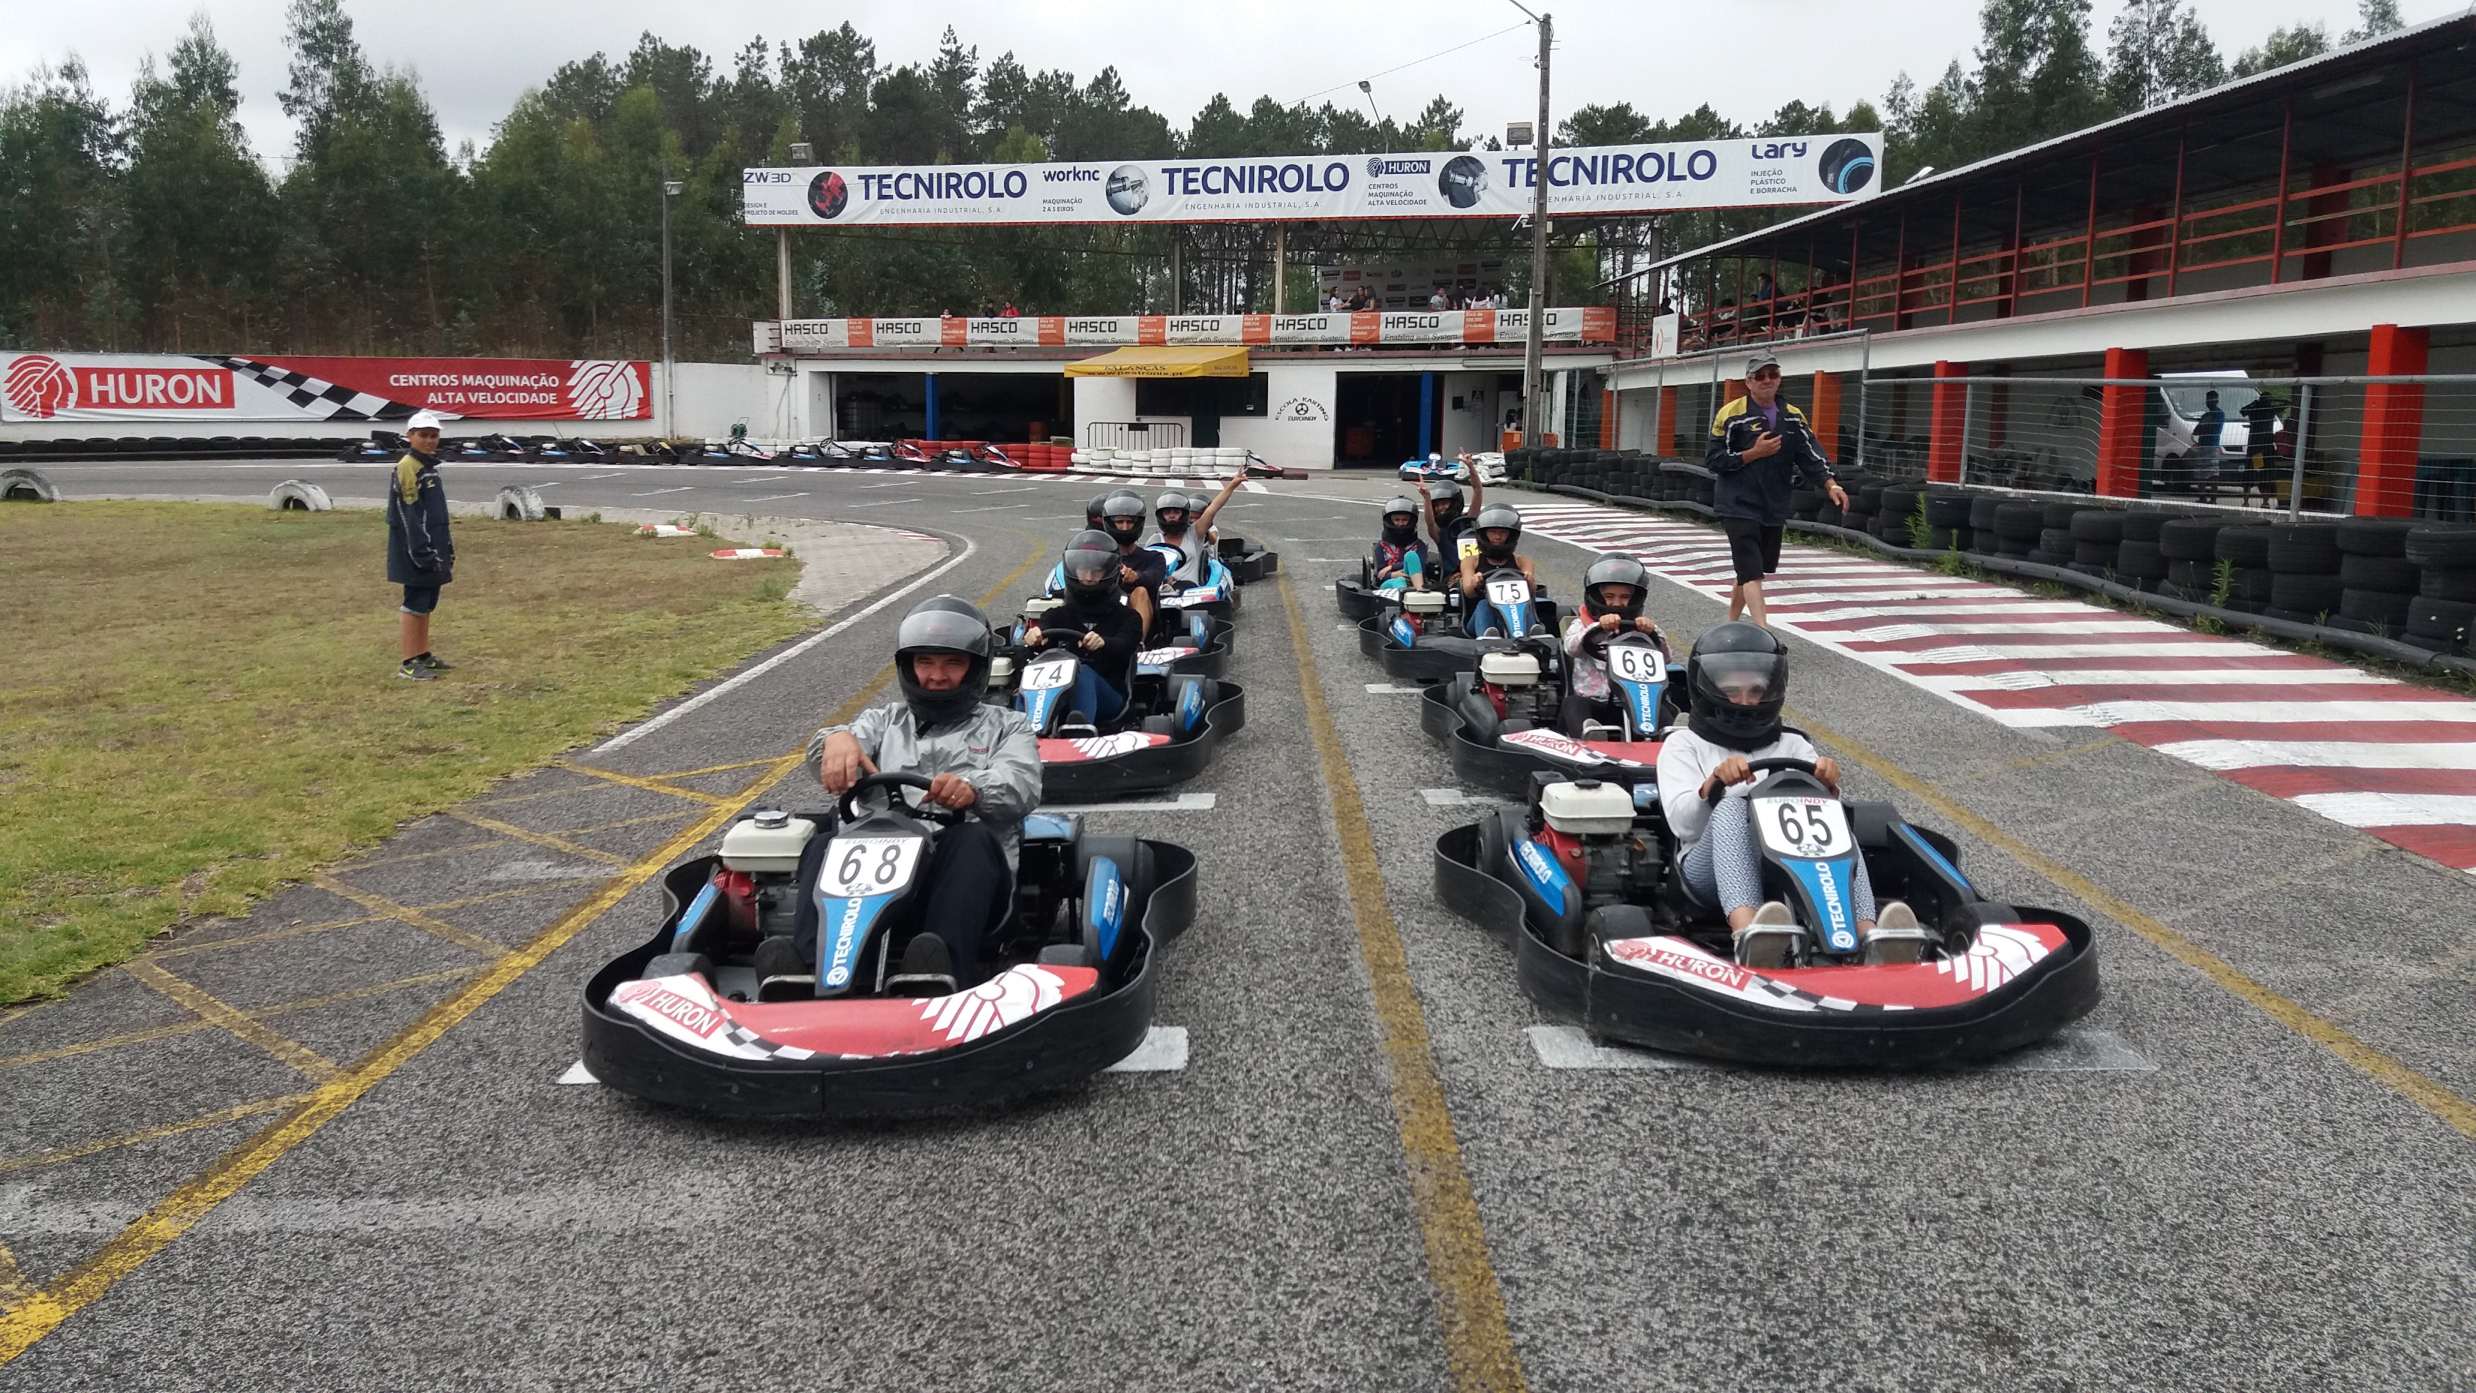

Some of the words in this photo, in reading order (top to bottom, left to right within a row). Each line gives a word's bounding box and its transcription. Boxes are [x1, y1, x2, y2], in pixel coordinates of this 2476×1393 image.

[1042, 165, 1101, 182] worknc
[1388, 161, 1428, 173] HURON
[1502, 149, 1717, 188] TECNIROLO
[1750, 169, 1783, 178] INJEÇÃO
[857, 170, 1028, 201] TECNIROLO
[1161, 162, 1350, 196] TECNIROLO
[1368, 190, 1414, 198] MAQUINAÇÃO
[1527, 193, 1592, 204] EENHARIA
[1756, 186, 1798, 194] BORRACHA
[1042, 196, 1083, 205] MAQUINAÇÃO
[1185, 202, 1241, 210] ENGENHARIA
[876, 322, 921, 334] HASCO
[971, 321, 1018, 333] HASCO
[1069, 321, 1117, 333] HASCO
[1170, 320, 1220, 332] HASCO
[1275, 318, 1327, 331] HASCO
[1385, 316, 1439, 329] HASCO
[1500, 313, 1557, 326] HASO
[784, 323, 828, 335] HASCO
[89, 373, 223, 404] HURON
[389, 374, 460, 387] CENTROS
[461, 372, 560, 389] MAQUINAÇÃO
[427, 391, 465, 404] ALTA
[467, 391, 558, 404] VELOCIDADE
[1302, 396, 1329, 422] KARTING
[1495, 583, 1521, 601] 75
[1622, 649, 1657, 677] 69
[1032, 663, 1063, 686] 74
[1529, 735, 1579, 755] HURON
[1778, 802, 1833, 847] 65
[838, 843, 901, 885] 68
[1815, 861, 1847, 931] TECNIROLO
[831, 897, 863, 968] TECNIROLO
[1656, 952, 1745, 986] HURON
[649, 992, 720, 1034] HURON
